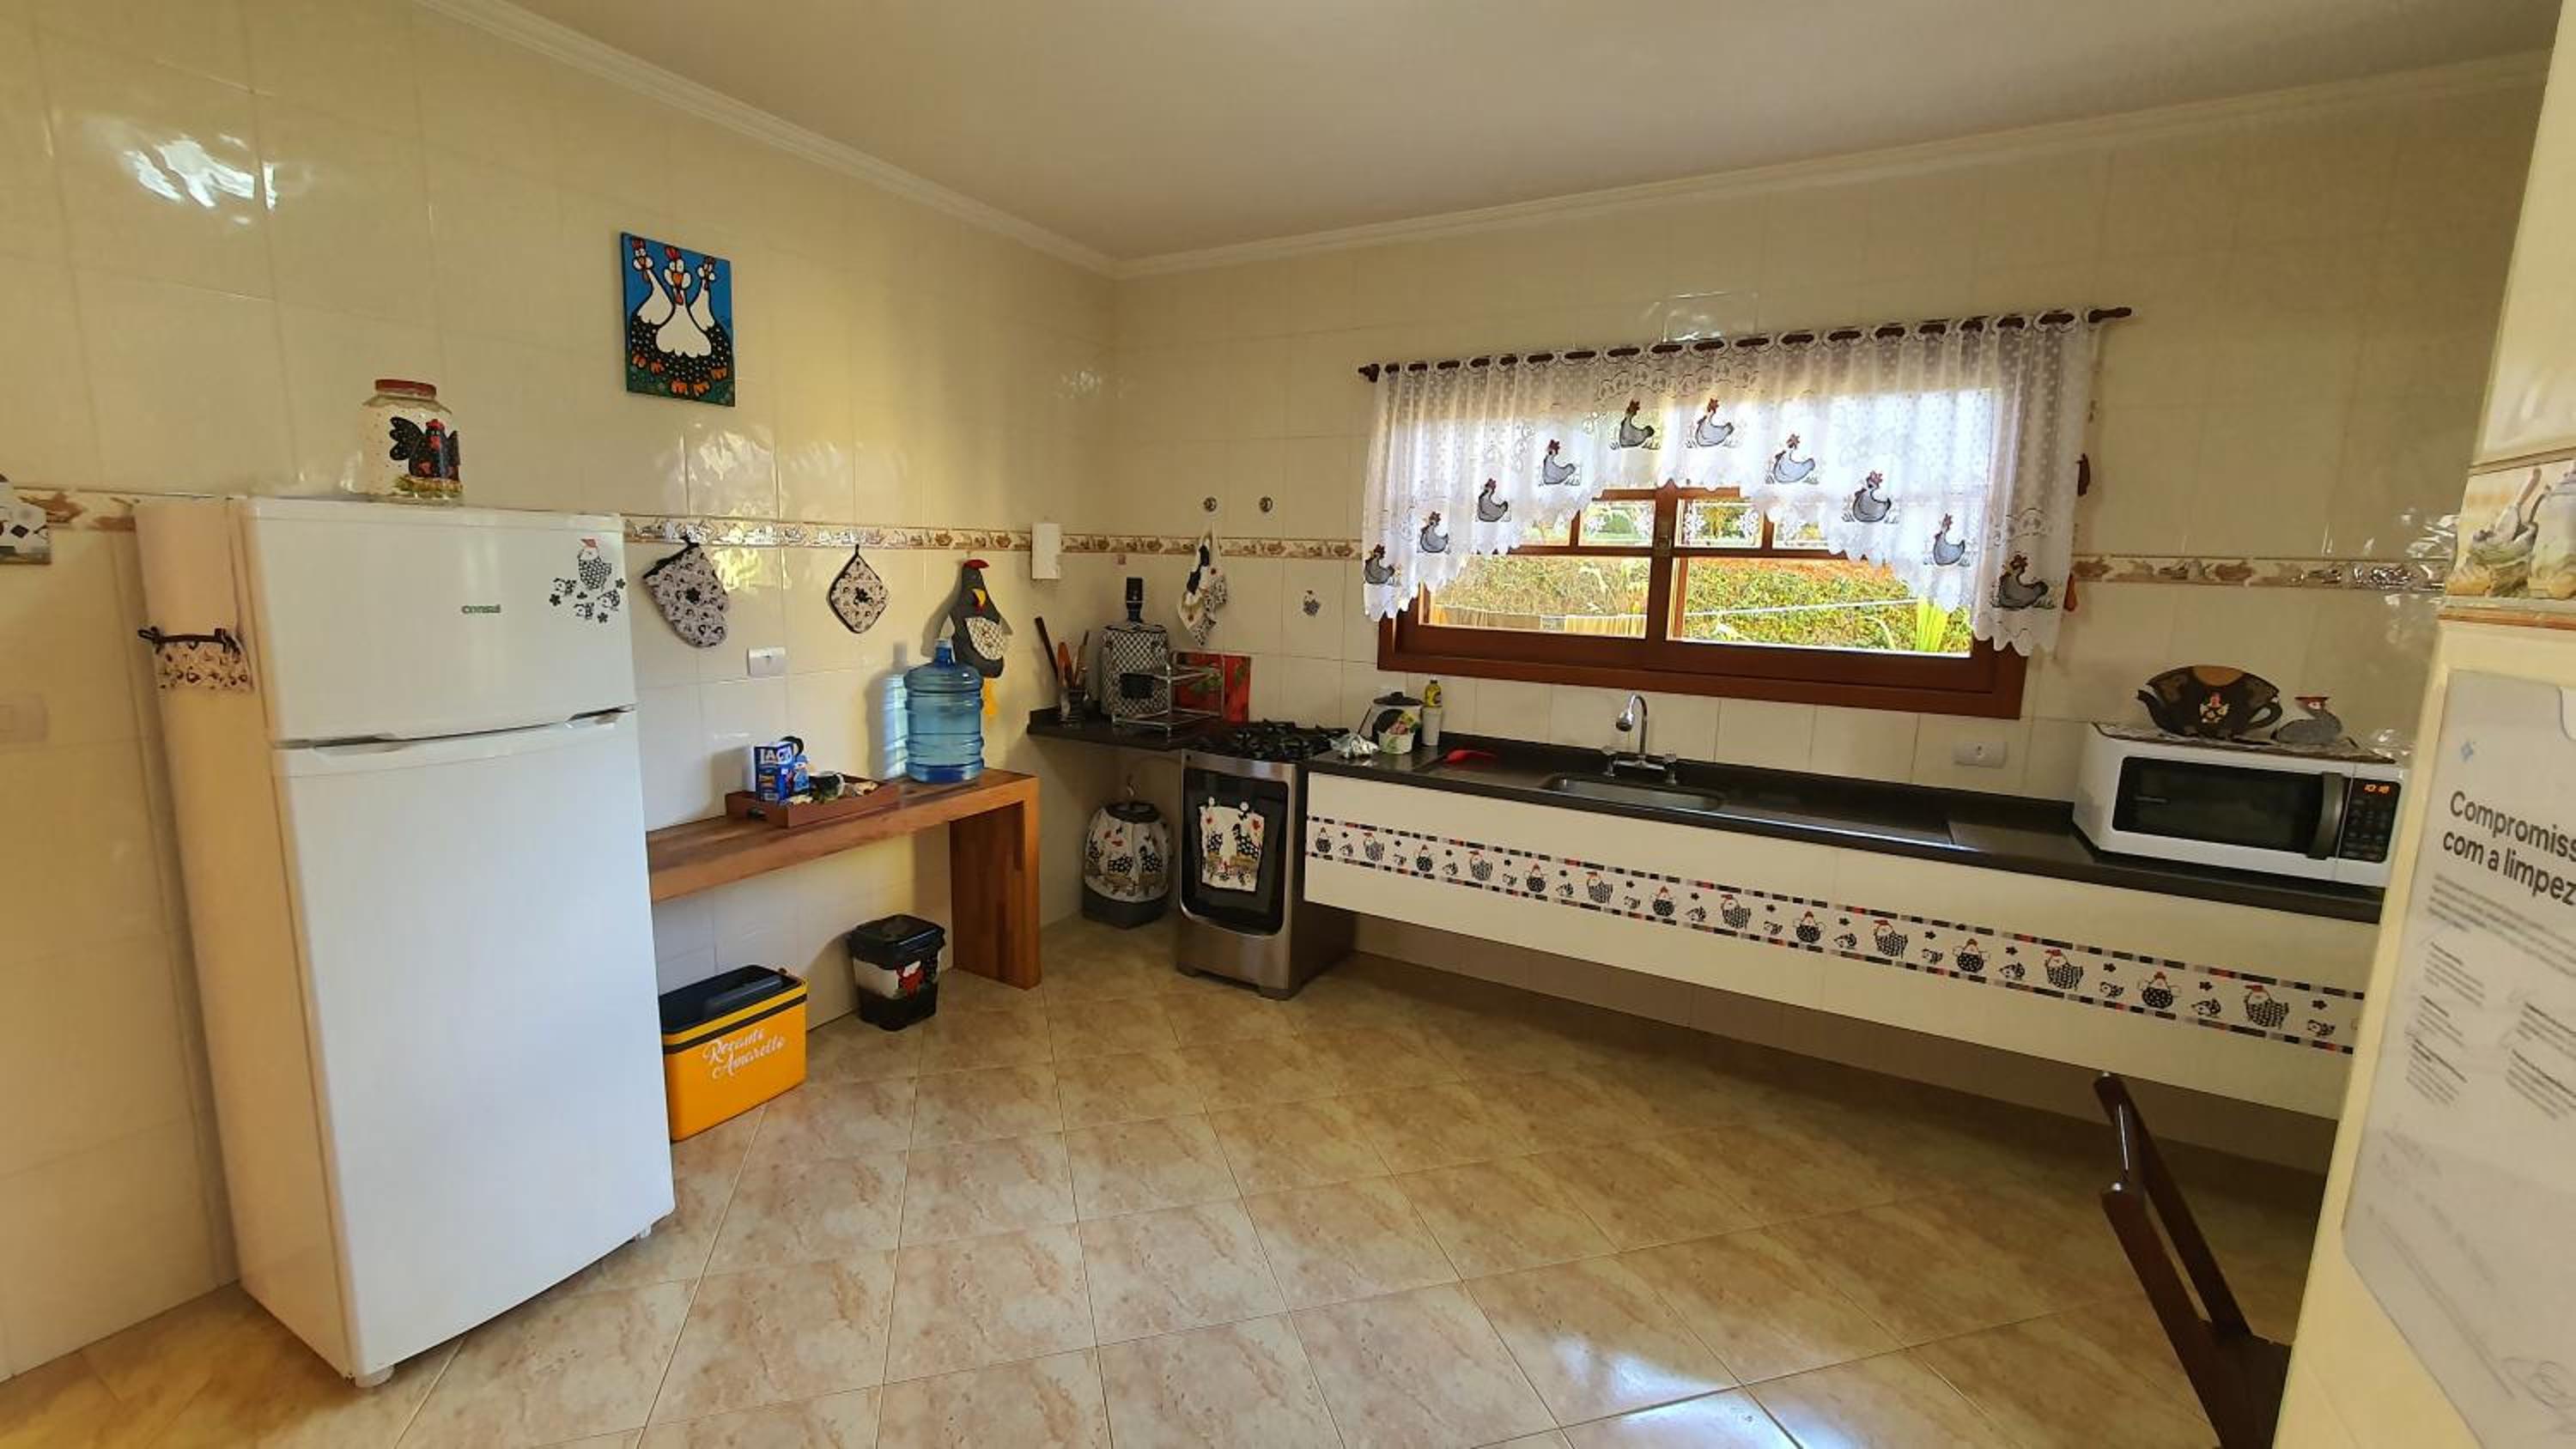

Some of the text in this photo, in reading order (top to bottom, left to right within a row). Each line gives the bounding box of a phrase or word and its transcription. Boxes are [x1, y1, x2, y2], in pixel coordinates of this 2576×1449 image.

[2443, 831, 2576, 906] com a limpez
